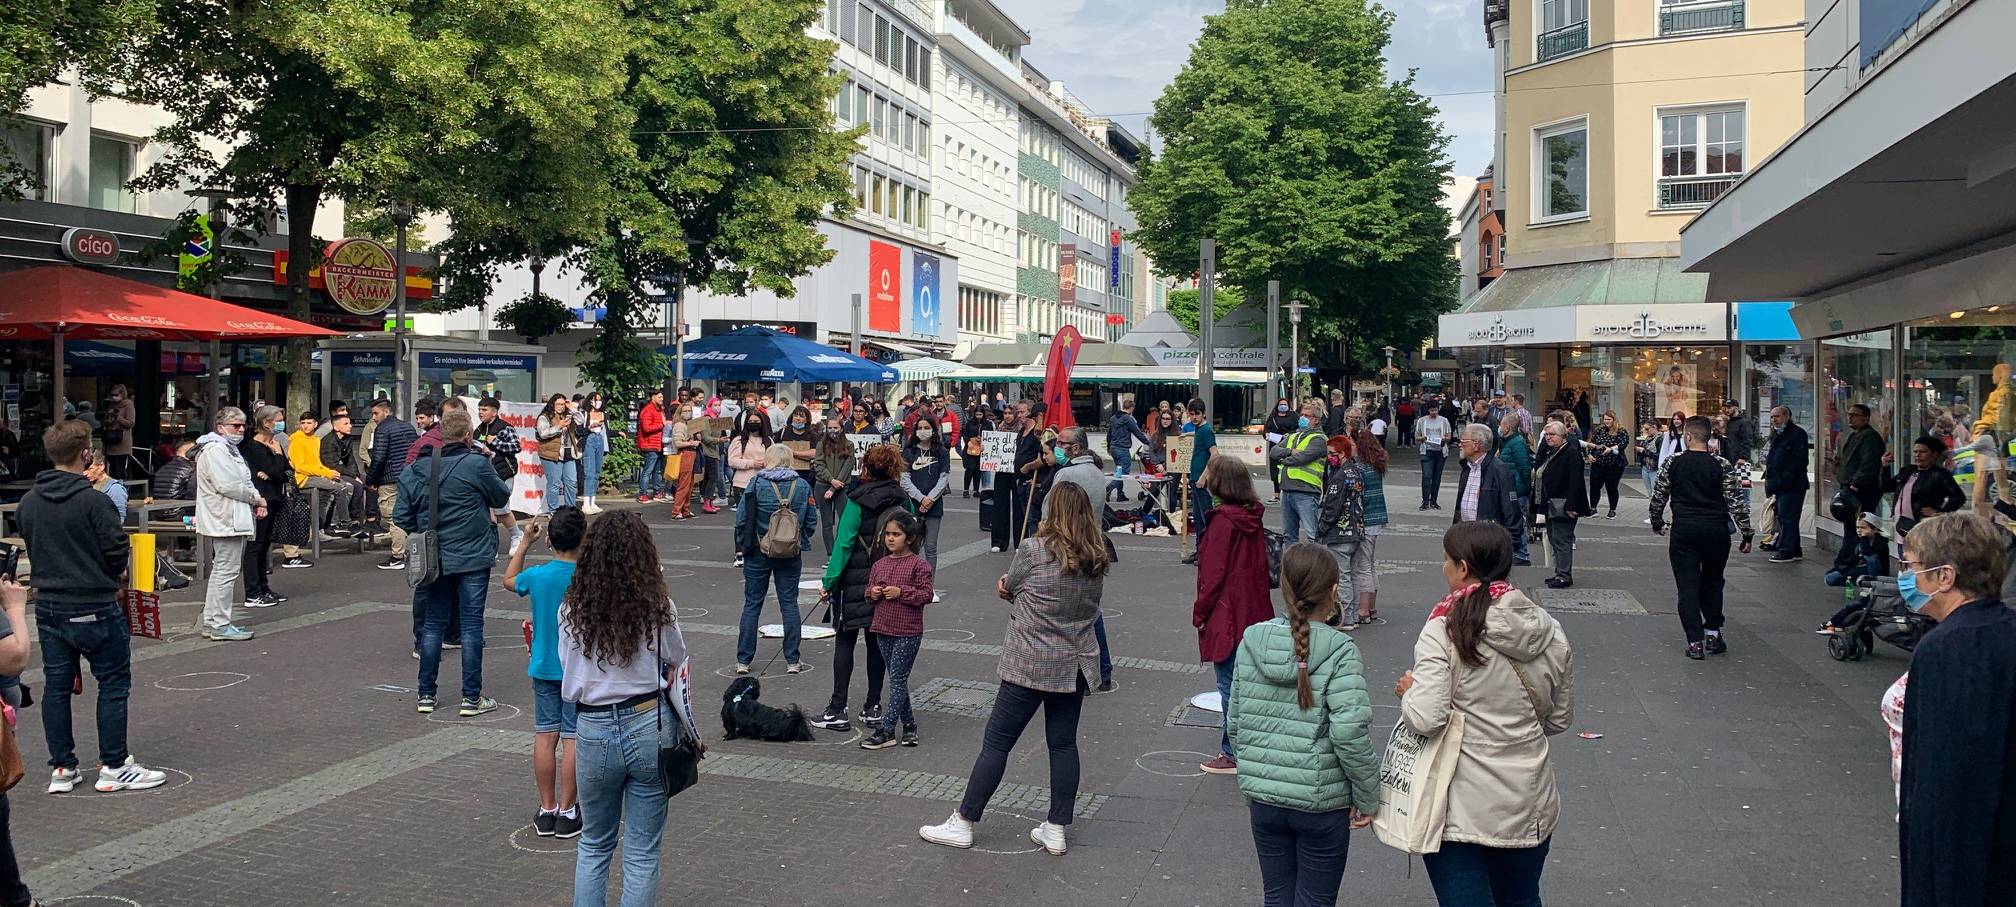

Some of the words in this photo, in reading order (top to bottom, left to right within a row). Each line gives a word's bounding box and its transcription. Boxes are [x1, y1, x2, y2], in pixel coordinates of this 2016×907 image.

[337, 274, 391, 300] KAMM
[1594, 323, 1631, 336] BIJOU
[1219, 350, 1265, 359] centrale
[760, 368, 784, 377] LAVAZZA
[980, 462, 999, 471] LOVE
[144, 612, 156, 637] vor
